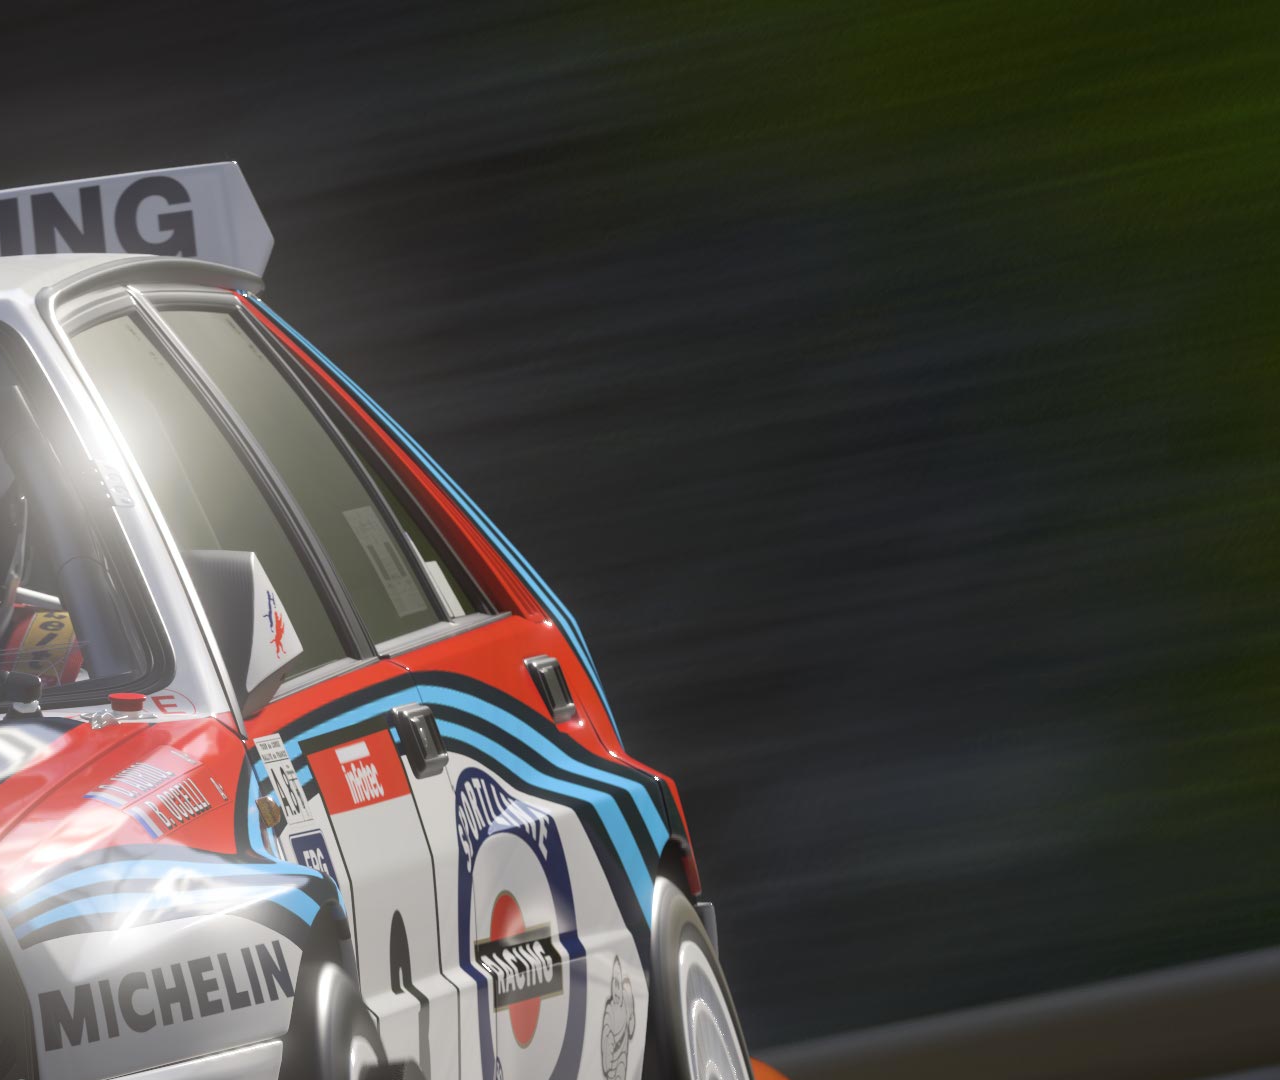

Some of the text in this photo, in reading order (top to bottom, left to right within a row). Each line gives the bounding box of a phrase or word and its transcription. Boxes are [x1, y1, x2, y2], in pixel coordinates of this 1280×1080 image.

[155, 777, 213, 824] OCCELLI
[457, 777, 550, 874] SPORTLINE
[37, 940, 295, 1052] MICHELIN
[480, 940, 554, 995] RACING
